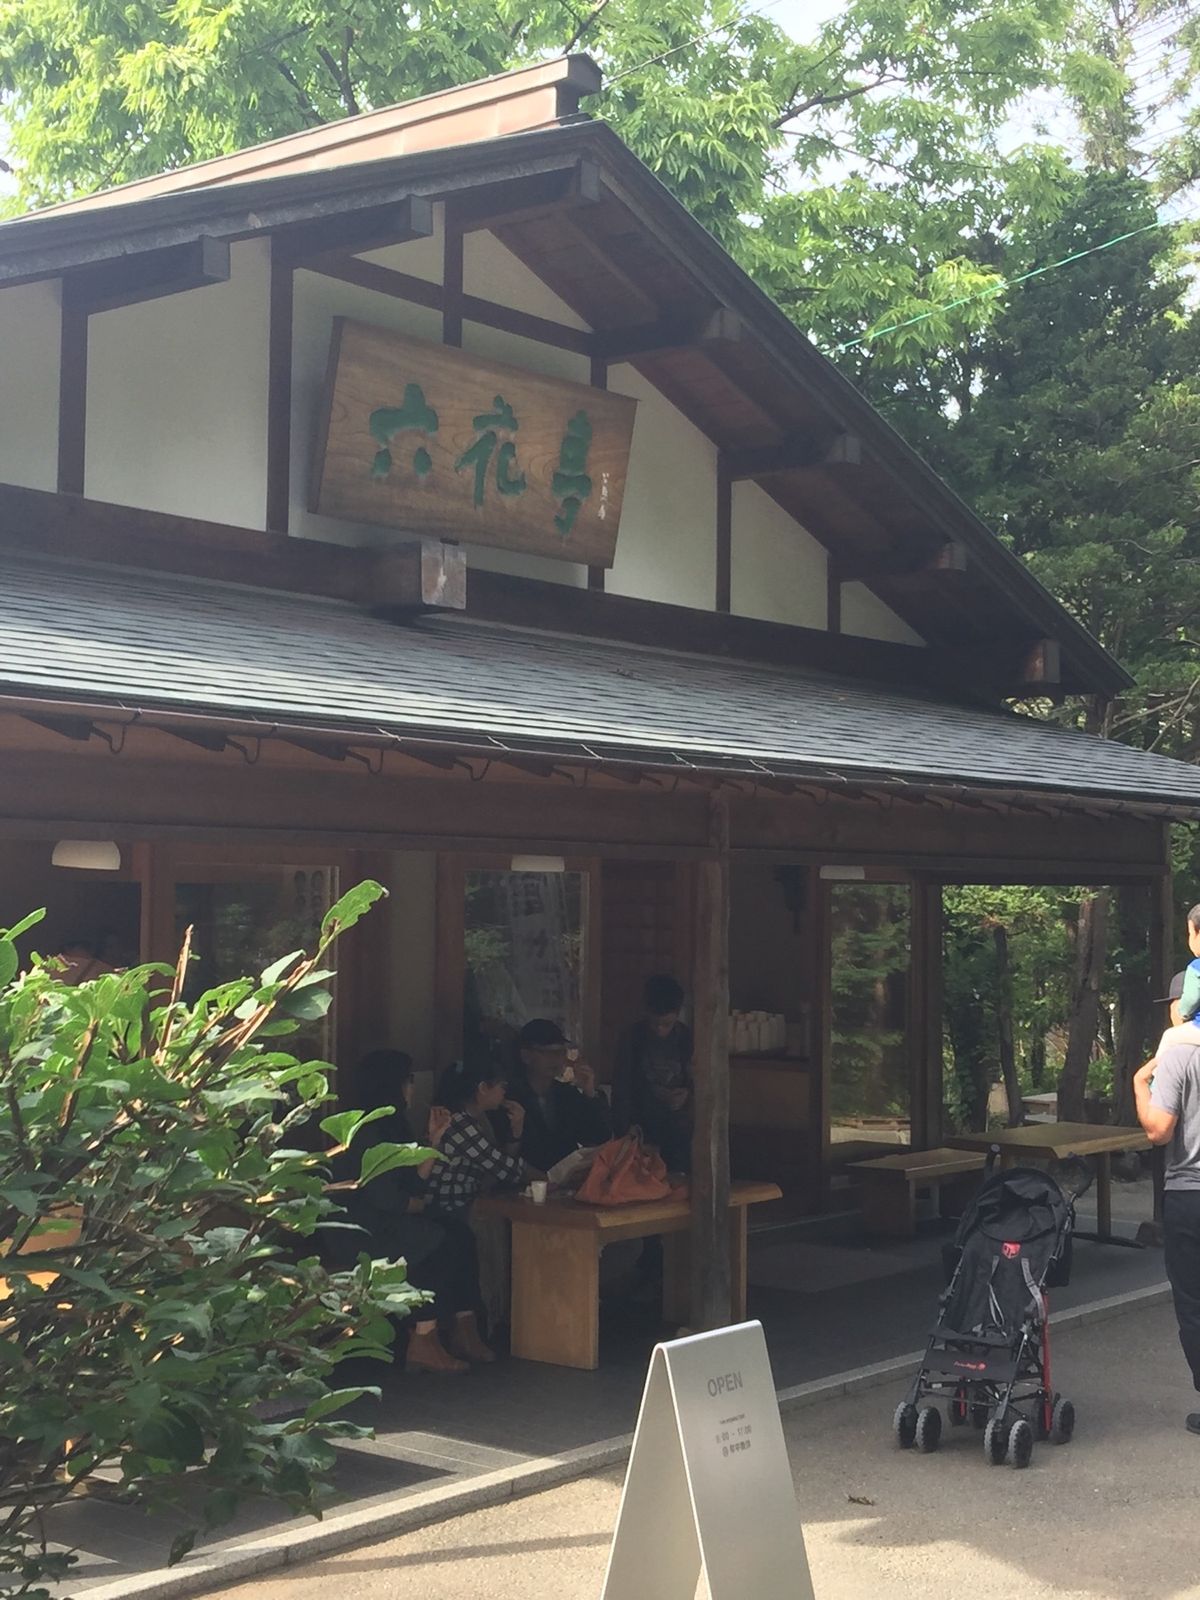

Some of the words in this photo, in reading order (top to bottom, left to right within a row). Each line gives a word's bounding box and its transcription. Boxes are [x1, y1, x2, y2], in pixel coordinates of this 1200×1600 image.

[368, 382, 592, 536] 六花亭
[707, 1371, 743, 1397] OPEN
